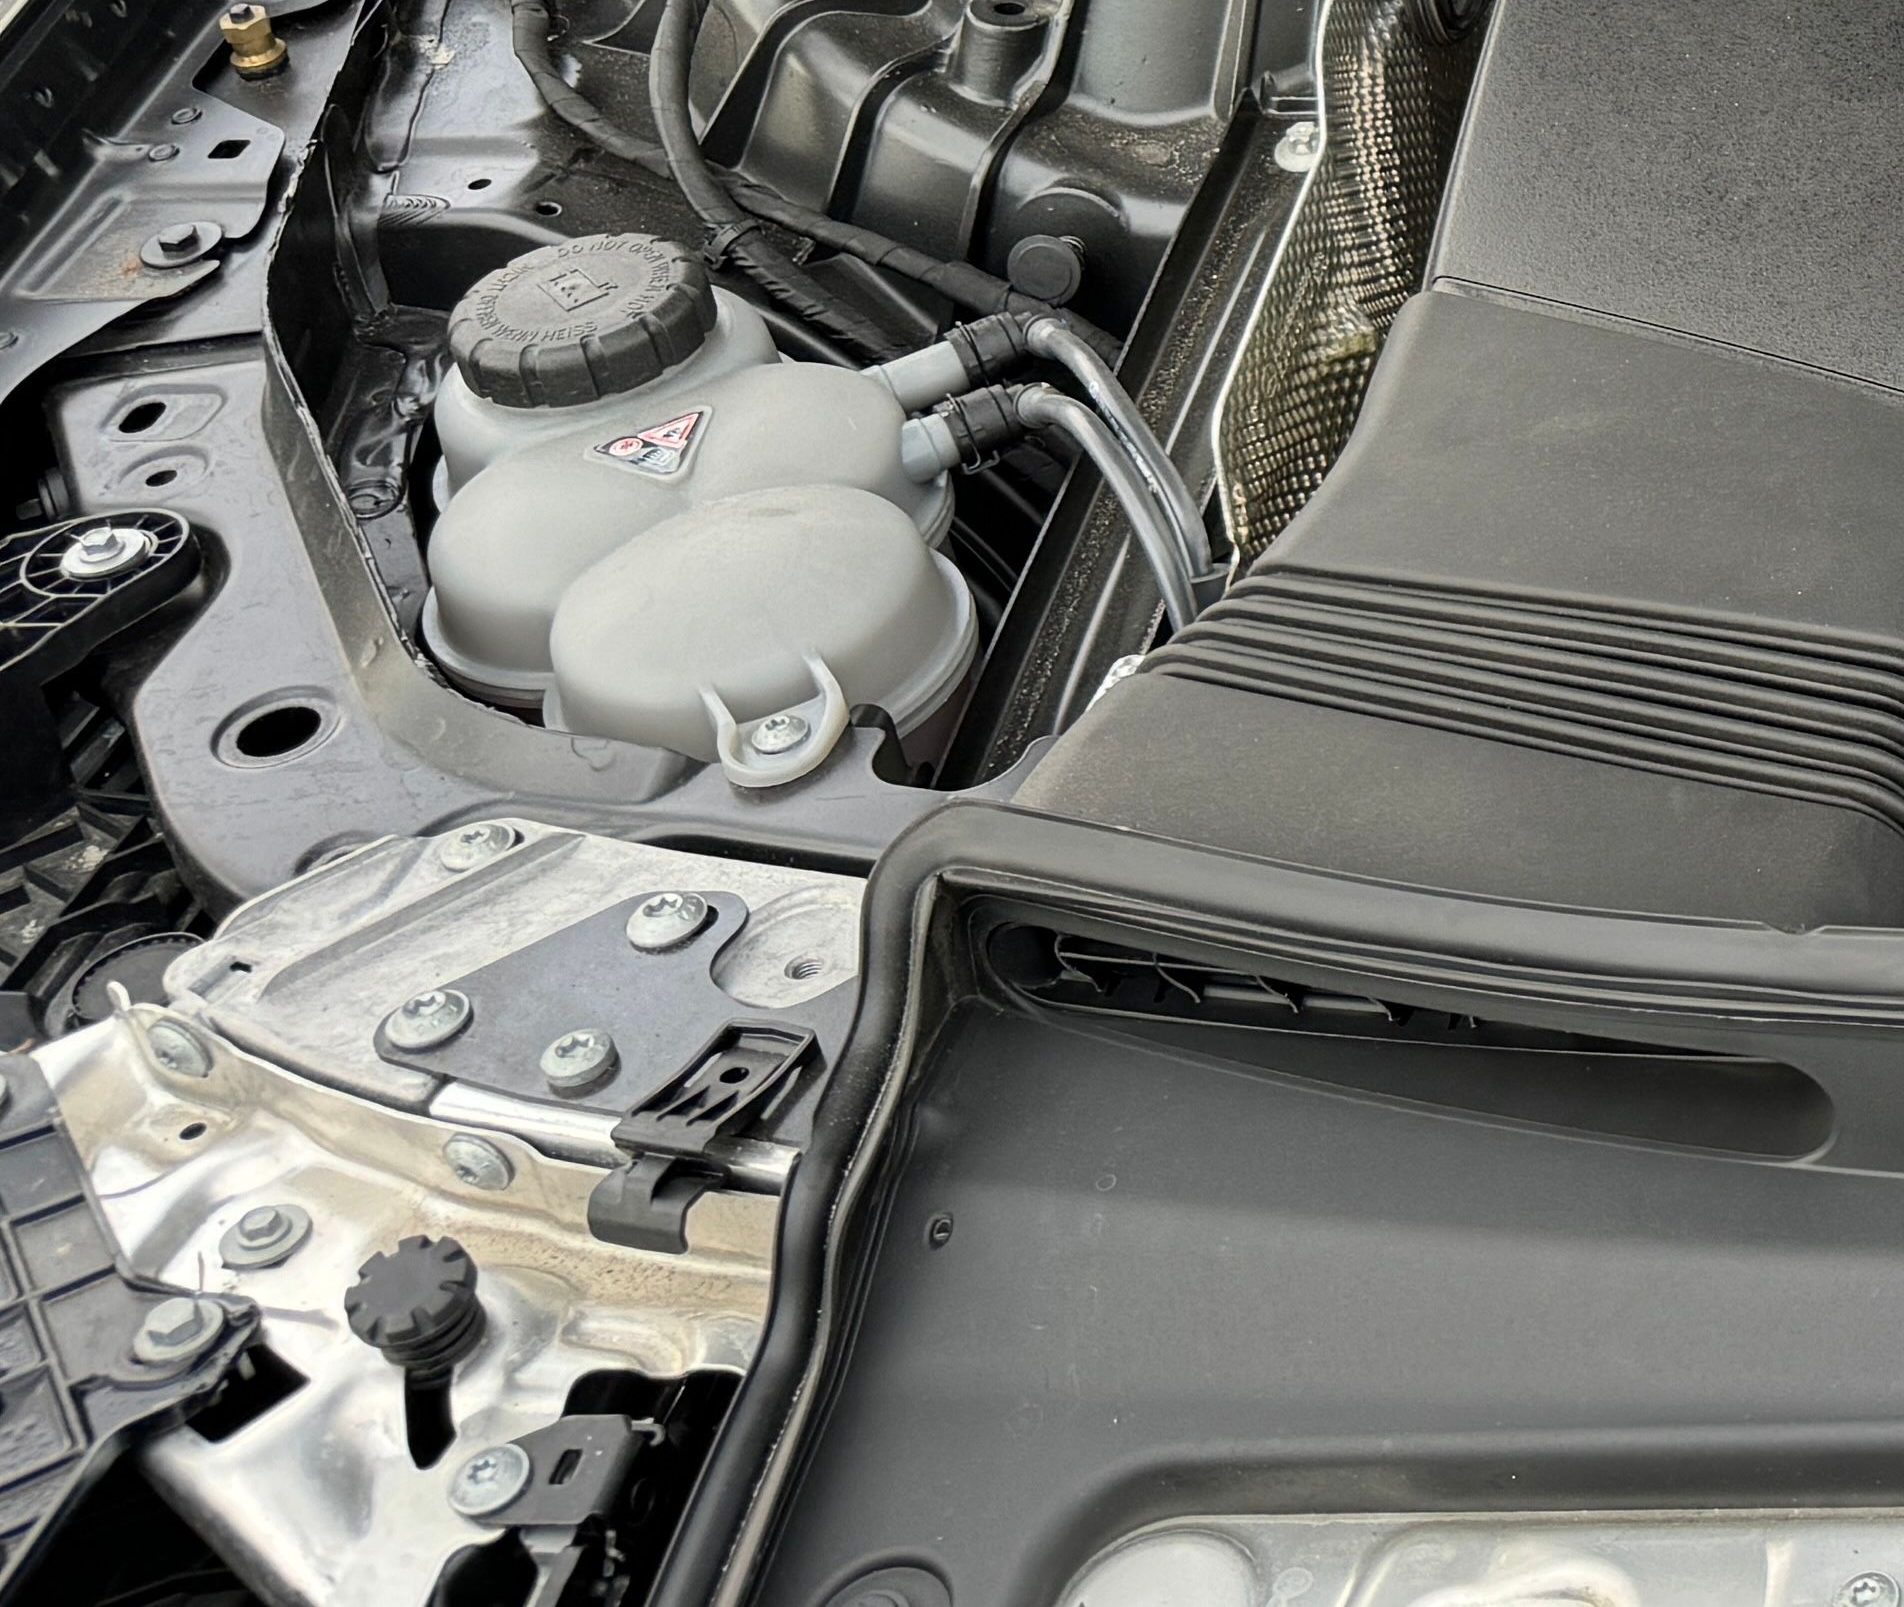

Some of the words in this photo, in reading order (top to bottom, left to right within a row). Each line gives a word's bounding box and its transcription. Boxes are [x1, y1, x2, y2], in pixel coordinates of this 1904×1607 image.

[557, 243, 584, 259] DO
[589, 240, 626, 253] NOT
[541, 321, 599, 342] HEISS
